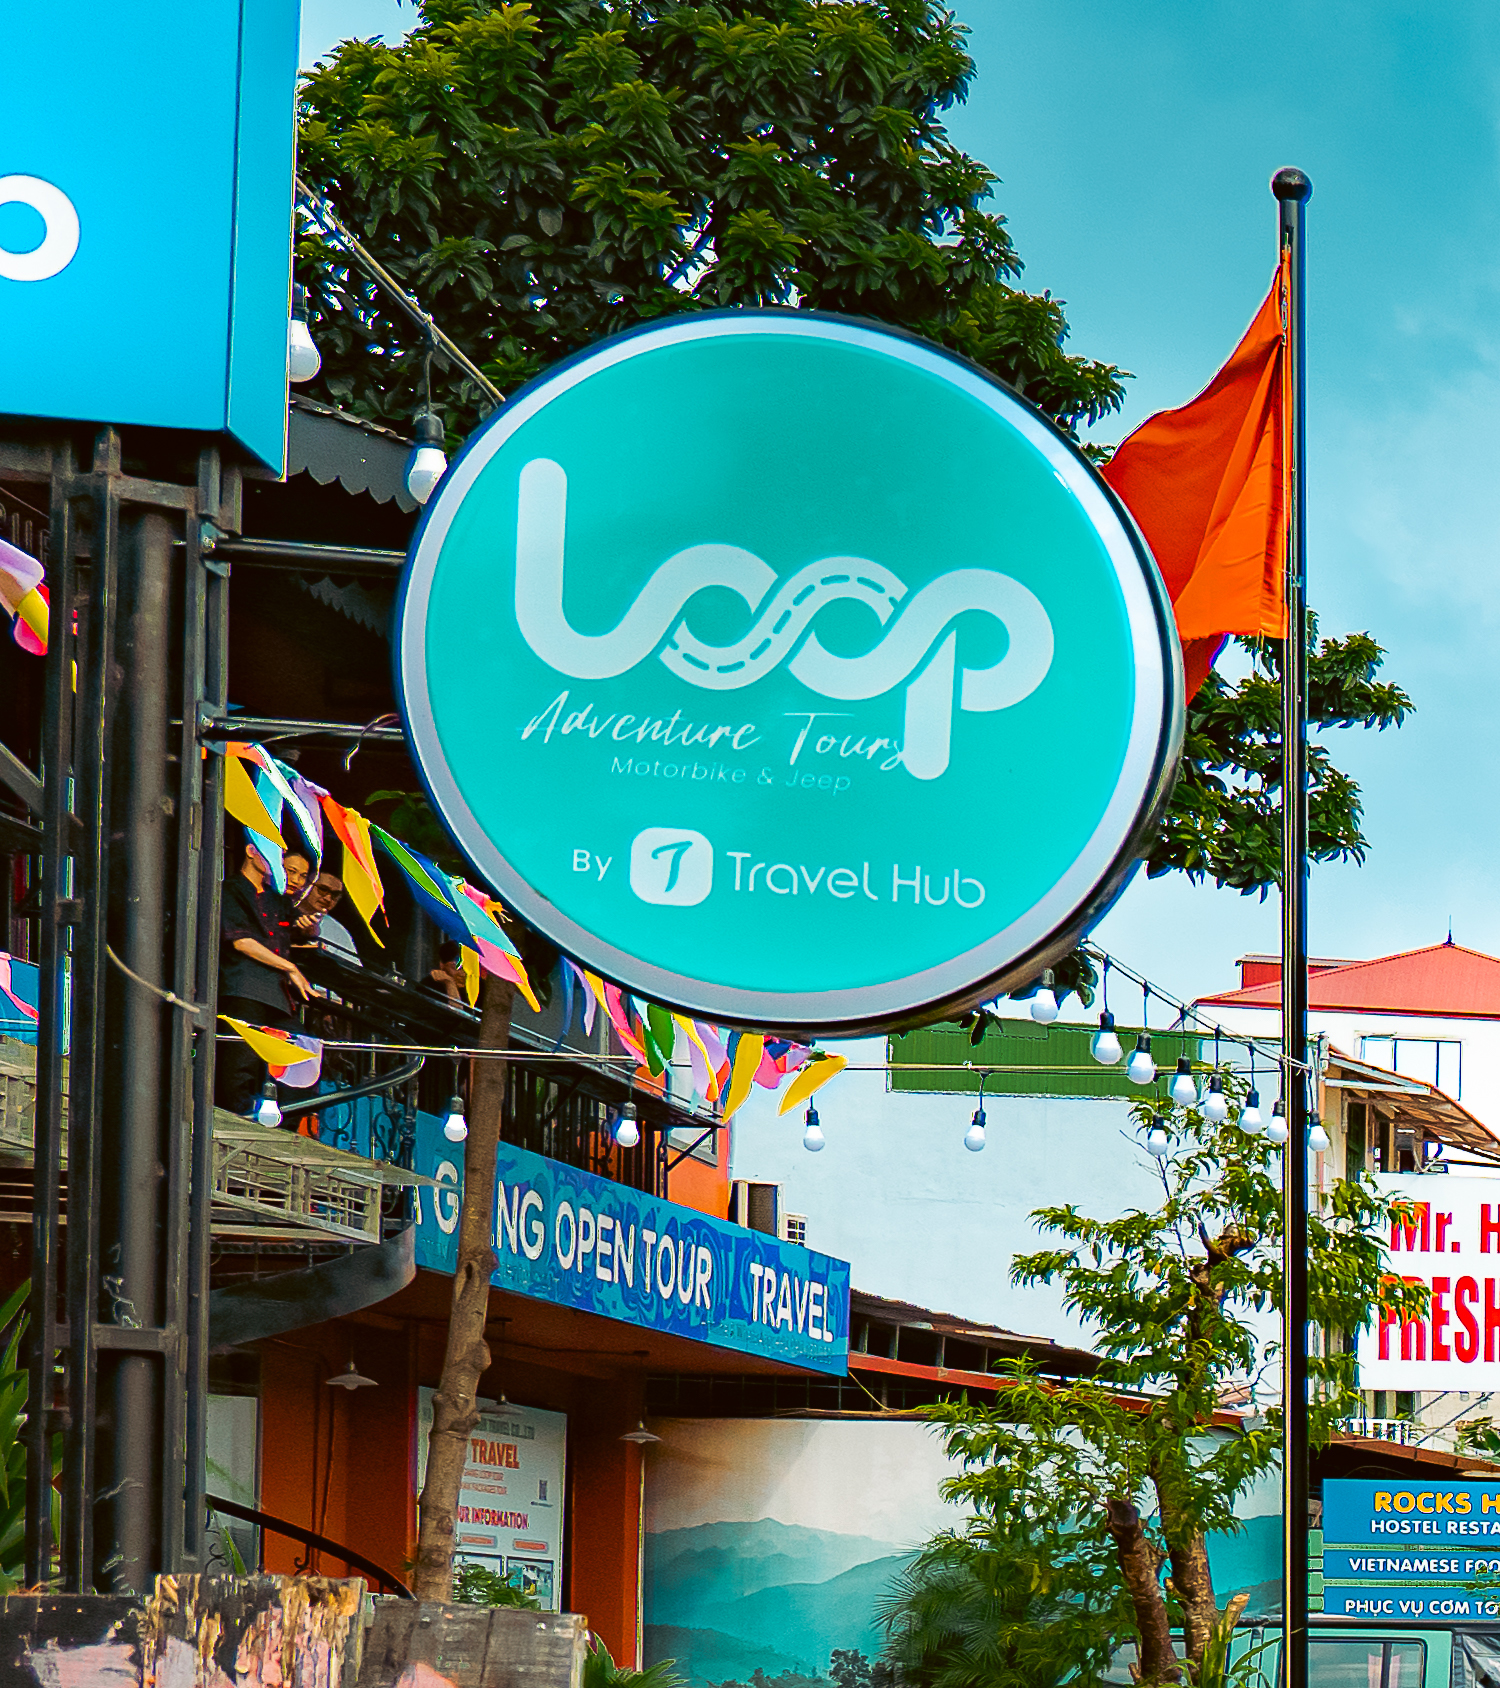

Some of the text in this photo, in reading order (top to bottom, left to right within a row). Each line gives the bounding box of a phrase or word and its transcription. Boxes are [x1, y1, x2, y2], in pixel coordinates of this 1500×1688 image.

[520, 690, 905, 772] Adventure Tours
[611, 756, 852, 797] Motorbike & Jeep
[572, 848, 613, 881] By
[727, 851, 880, 901] Travel
[892, 863, 986, 908] Hub
[1389, 1201, 1462, 1254] Mr.
[434, 1160, 545, 1261] GNG
[555, 1201, 636, 1289] OPEN
[642, 1229, 712, 1309] TOUR
[749, 1262, 834, 1343] TRAVEL
[471, 1438, 520, 1470] TRAVEL
[471, 1507, 530, 1530] INFORMATION
[1374, 1491, 1472, 1514] ROCKS
[1371, 1519, 1441, 1535] HOSTEL
[1349, 1558, 1459, 1574] VIETNAMESE
[1345, 1599, 1394, 1617] PHỤC
[1399, 1600, 1424, 1618] VỤ
[1429, 1598, 1471, 1615] CƠM
